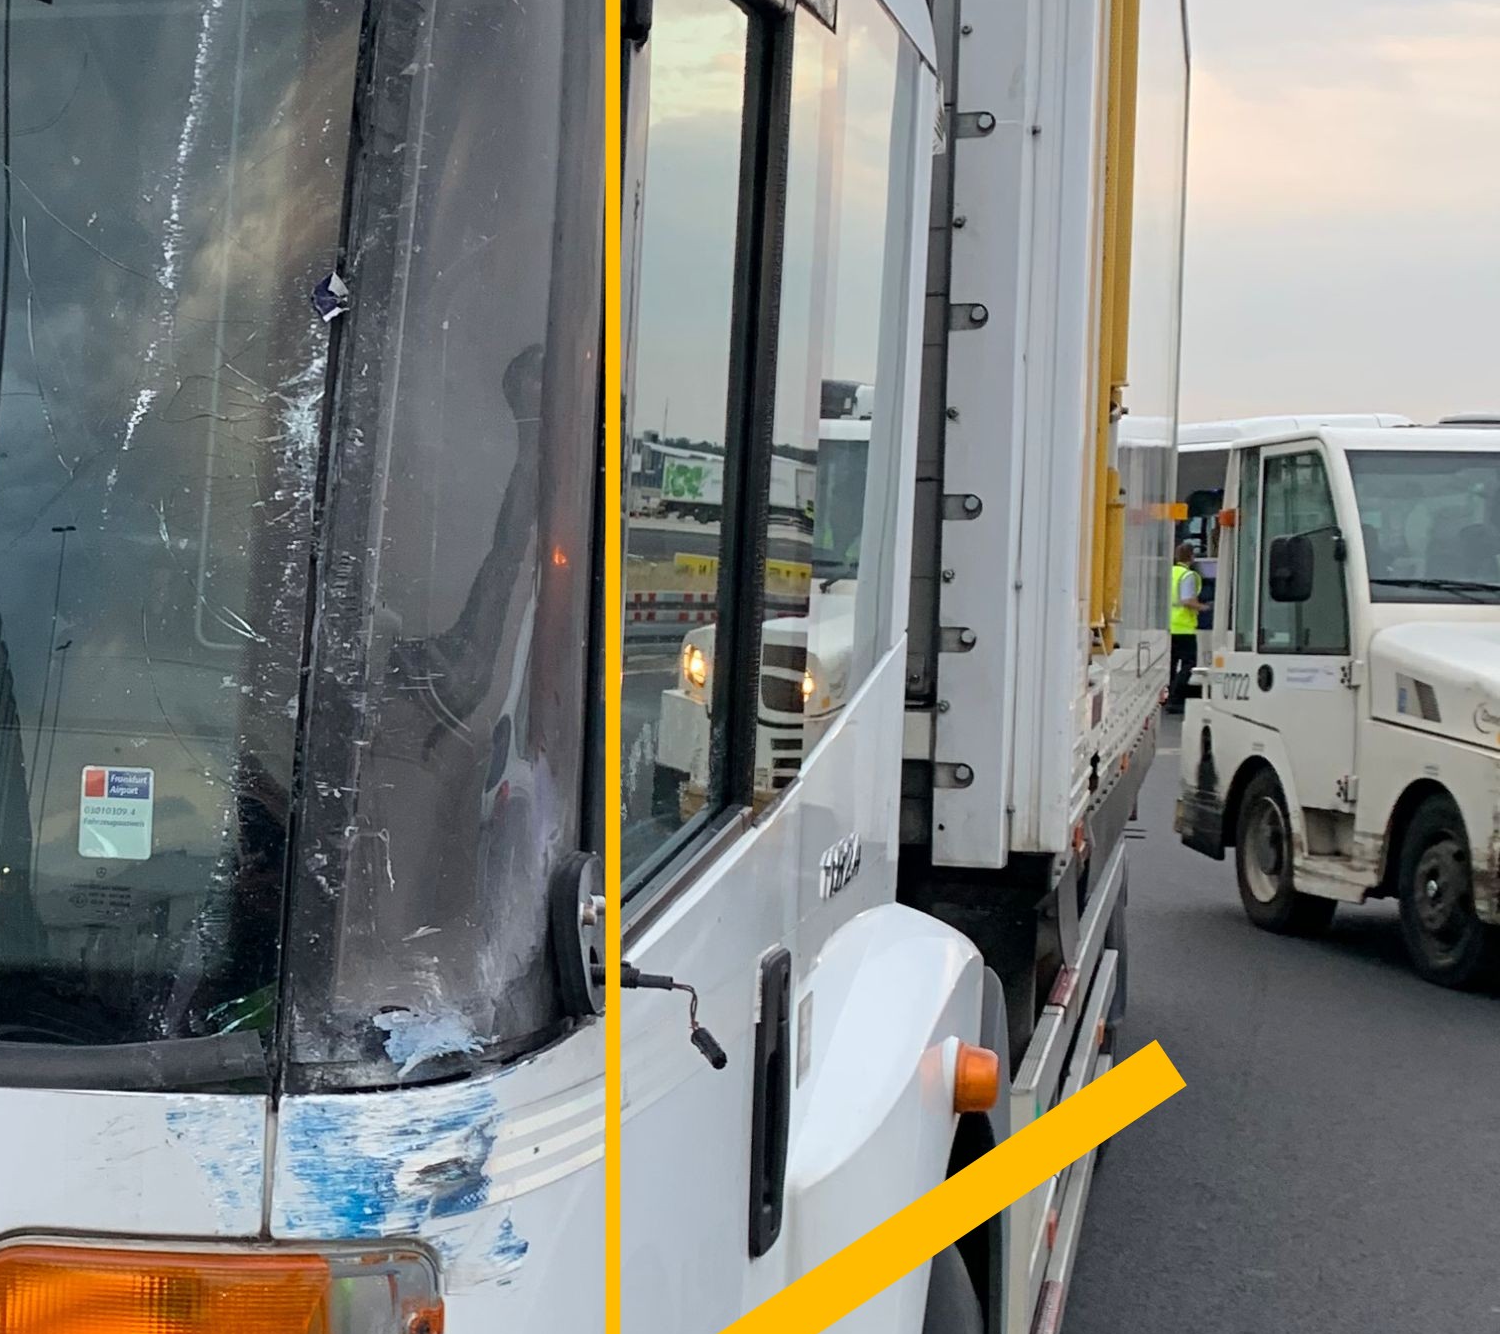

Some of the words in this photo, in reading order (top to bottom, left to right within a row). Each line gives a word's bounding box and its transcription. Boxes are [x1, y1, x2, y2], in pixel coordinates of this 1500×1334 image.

[1223, 672, 1251, 701] 0722
[110, 773, 148, 785] Frankfurt
[109, 785, 139, 796] Airport
